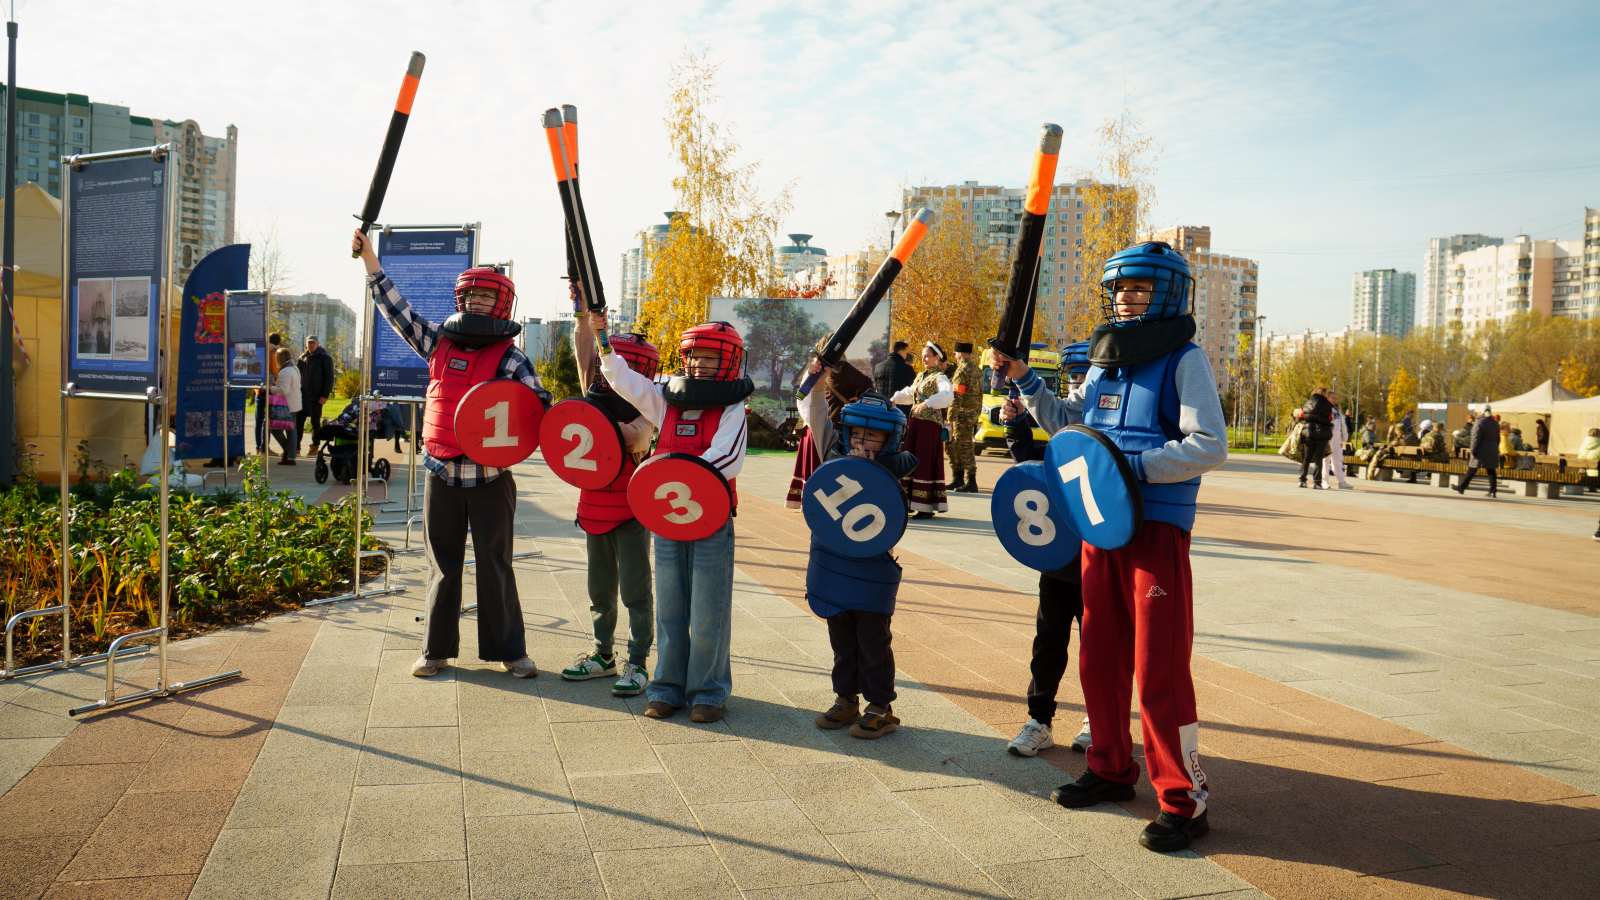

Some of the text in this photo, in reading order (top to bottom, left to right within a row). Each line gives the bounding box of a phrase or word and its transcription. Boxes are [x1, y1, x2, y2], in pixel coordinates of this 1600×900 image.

[482, 401, 519, 448] 1
[561, 423, 597, 471] 2
[654, 481, 703, 524] 3
[813, 474, 886, 542] 10
[1058, 455, 1105, 526] 7
[1014, 489, 1056, 546] 8
